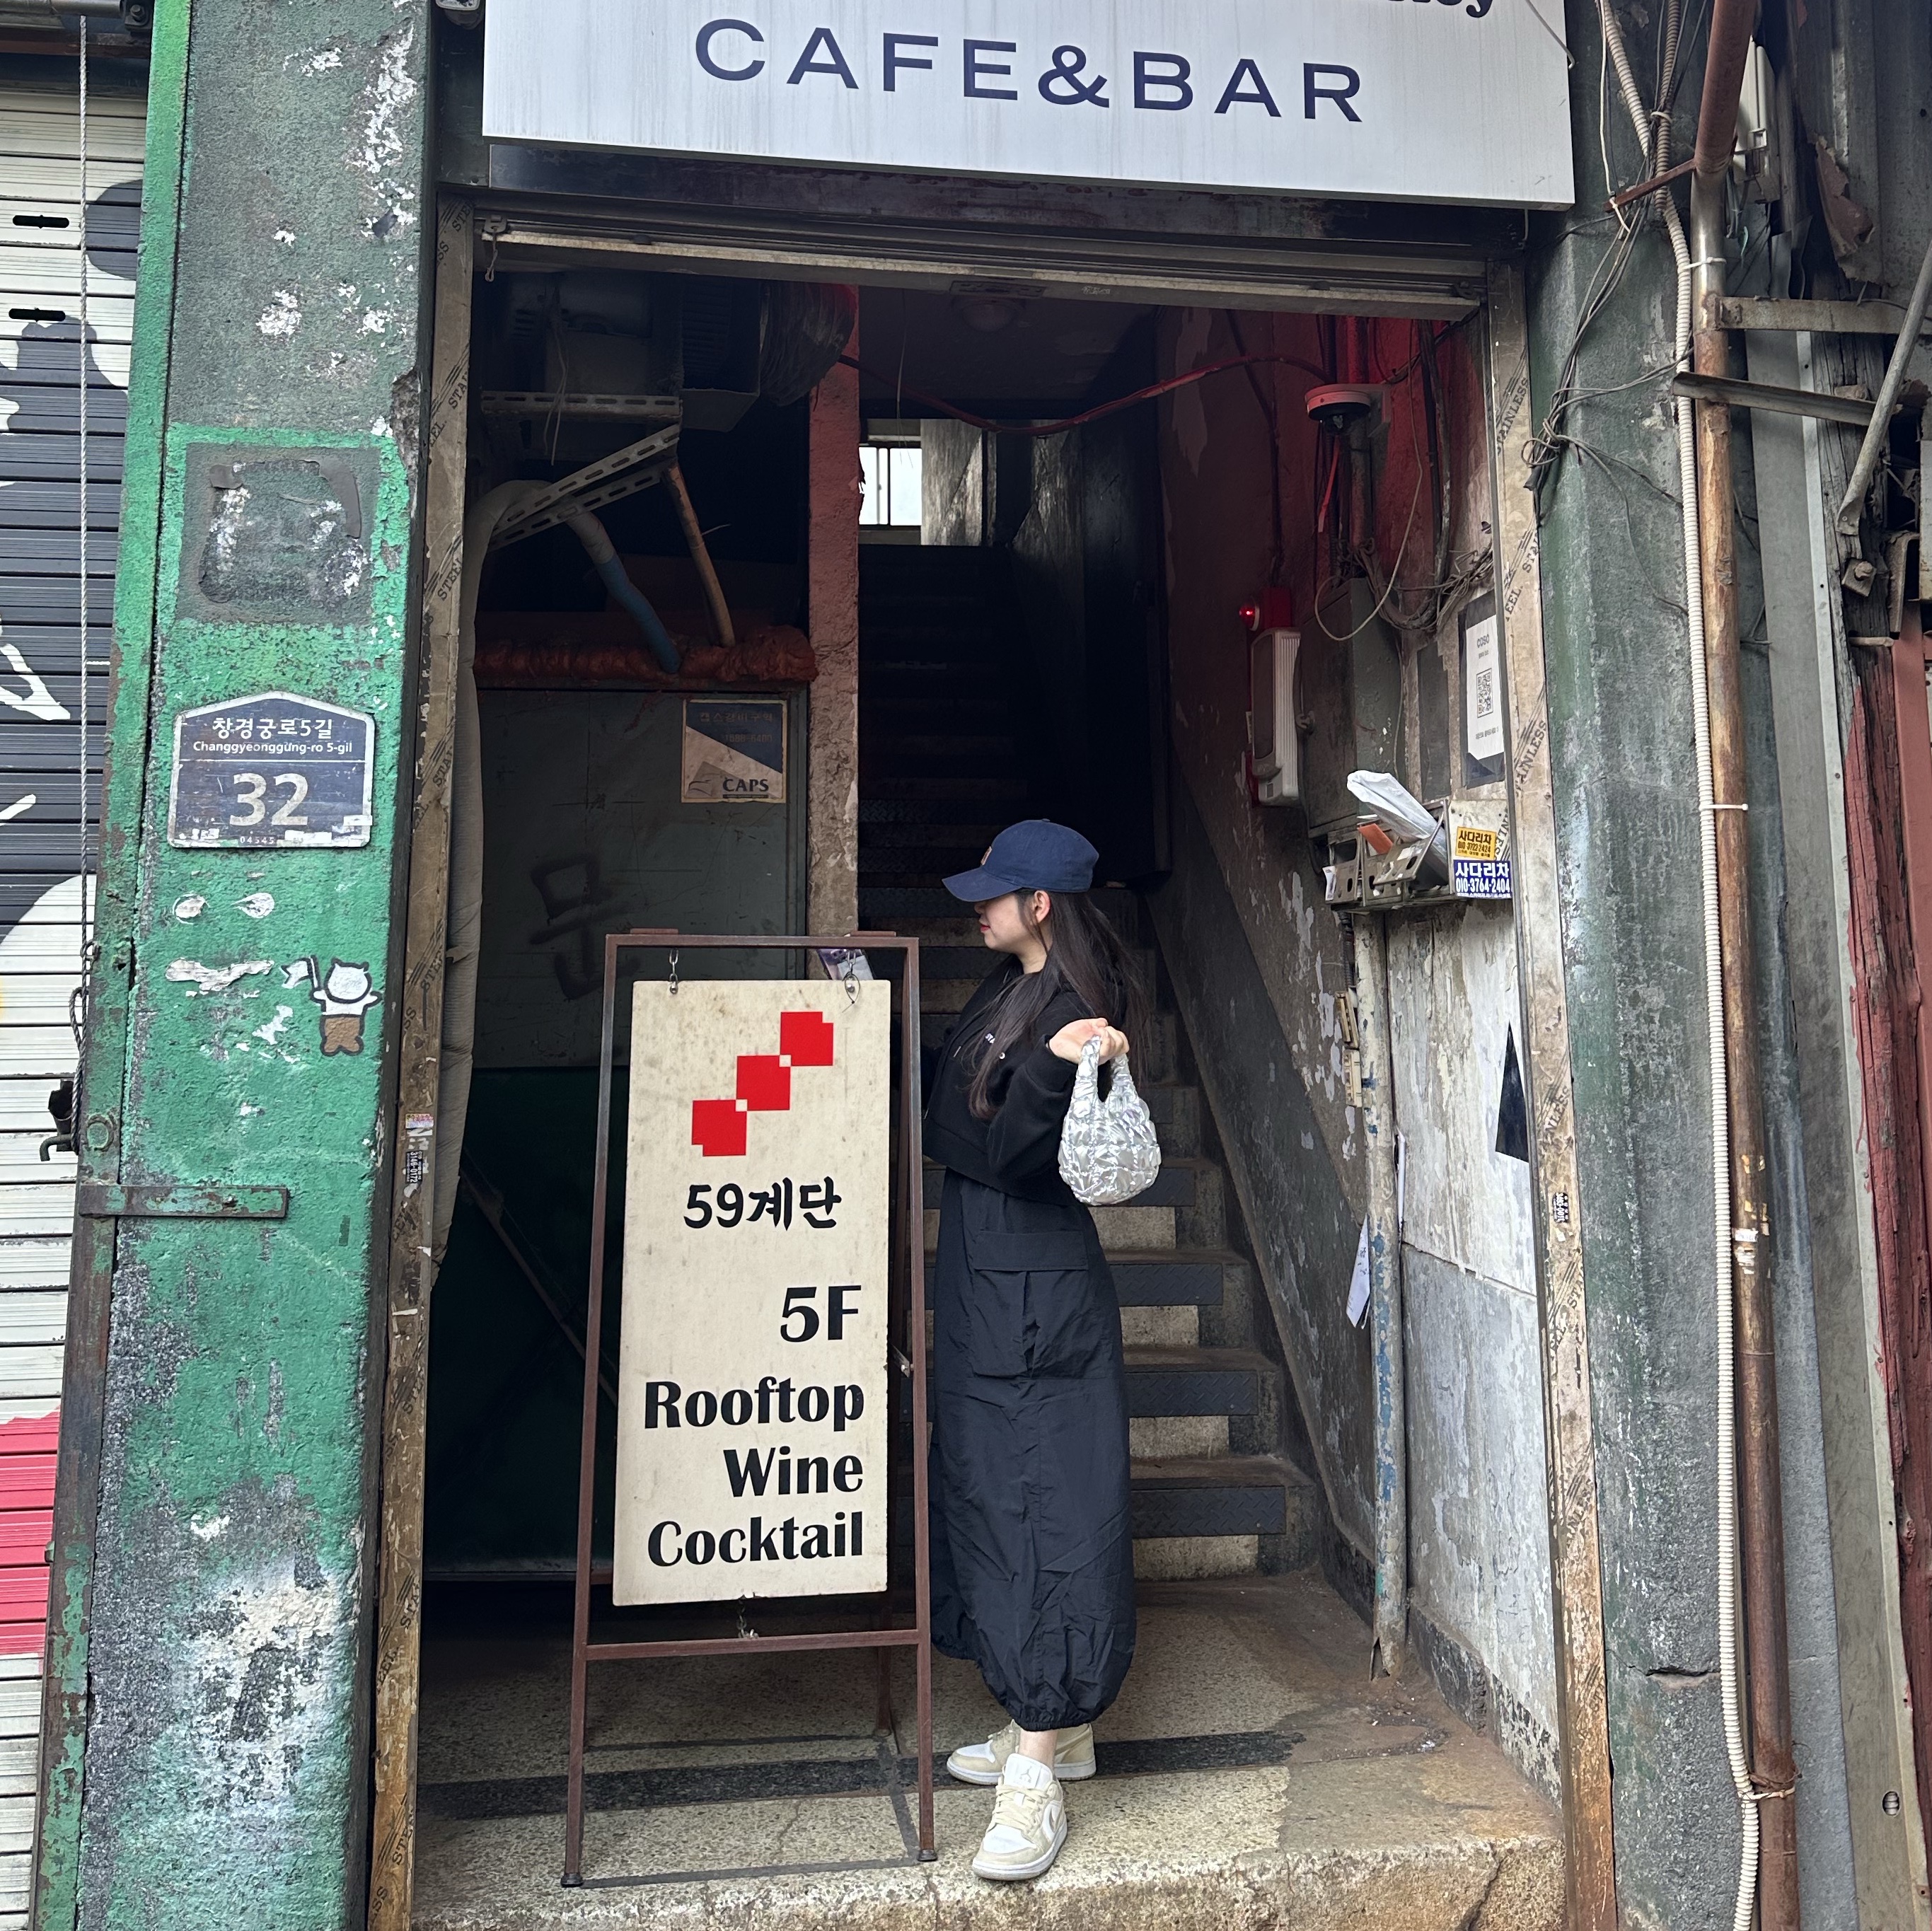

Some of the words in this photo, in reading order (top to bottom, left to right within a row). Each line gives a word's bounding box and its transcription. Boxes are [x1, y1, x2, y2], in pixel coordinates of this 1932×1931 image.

[695, 18, 1363, 123] CAFE&BAR
[1504, 585, 1523, 622] EEL.
[212, 717, 332, 740] 창경궁로5길
[326, 741, 352, 755] 5-gil
[229, 772, 308, 826] 32
[722, 778, 769, 792] CAPS
[239, 835, 275, 845] 04545
[1458, 830, 1492, 845] 사다리차
[1455, 862, 1510, 878] 사다리차
[1455, 877, 1510, 893] 010-3764-2404
[683, 1176, 843, 1231] 59계단
[780, 1285, 862, 1343] 5F
[644, 1376, 864, 1432] Rooftop
[723, 1445, 863, 1497] Wine
[647, 1511, 863, 1567] Cocktail
